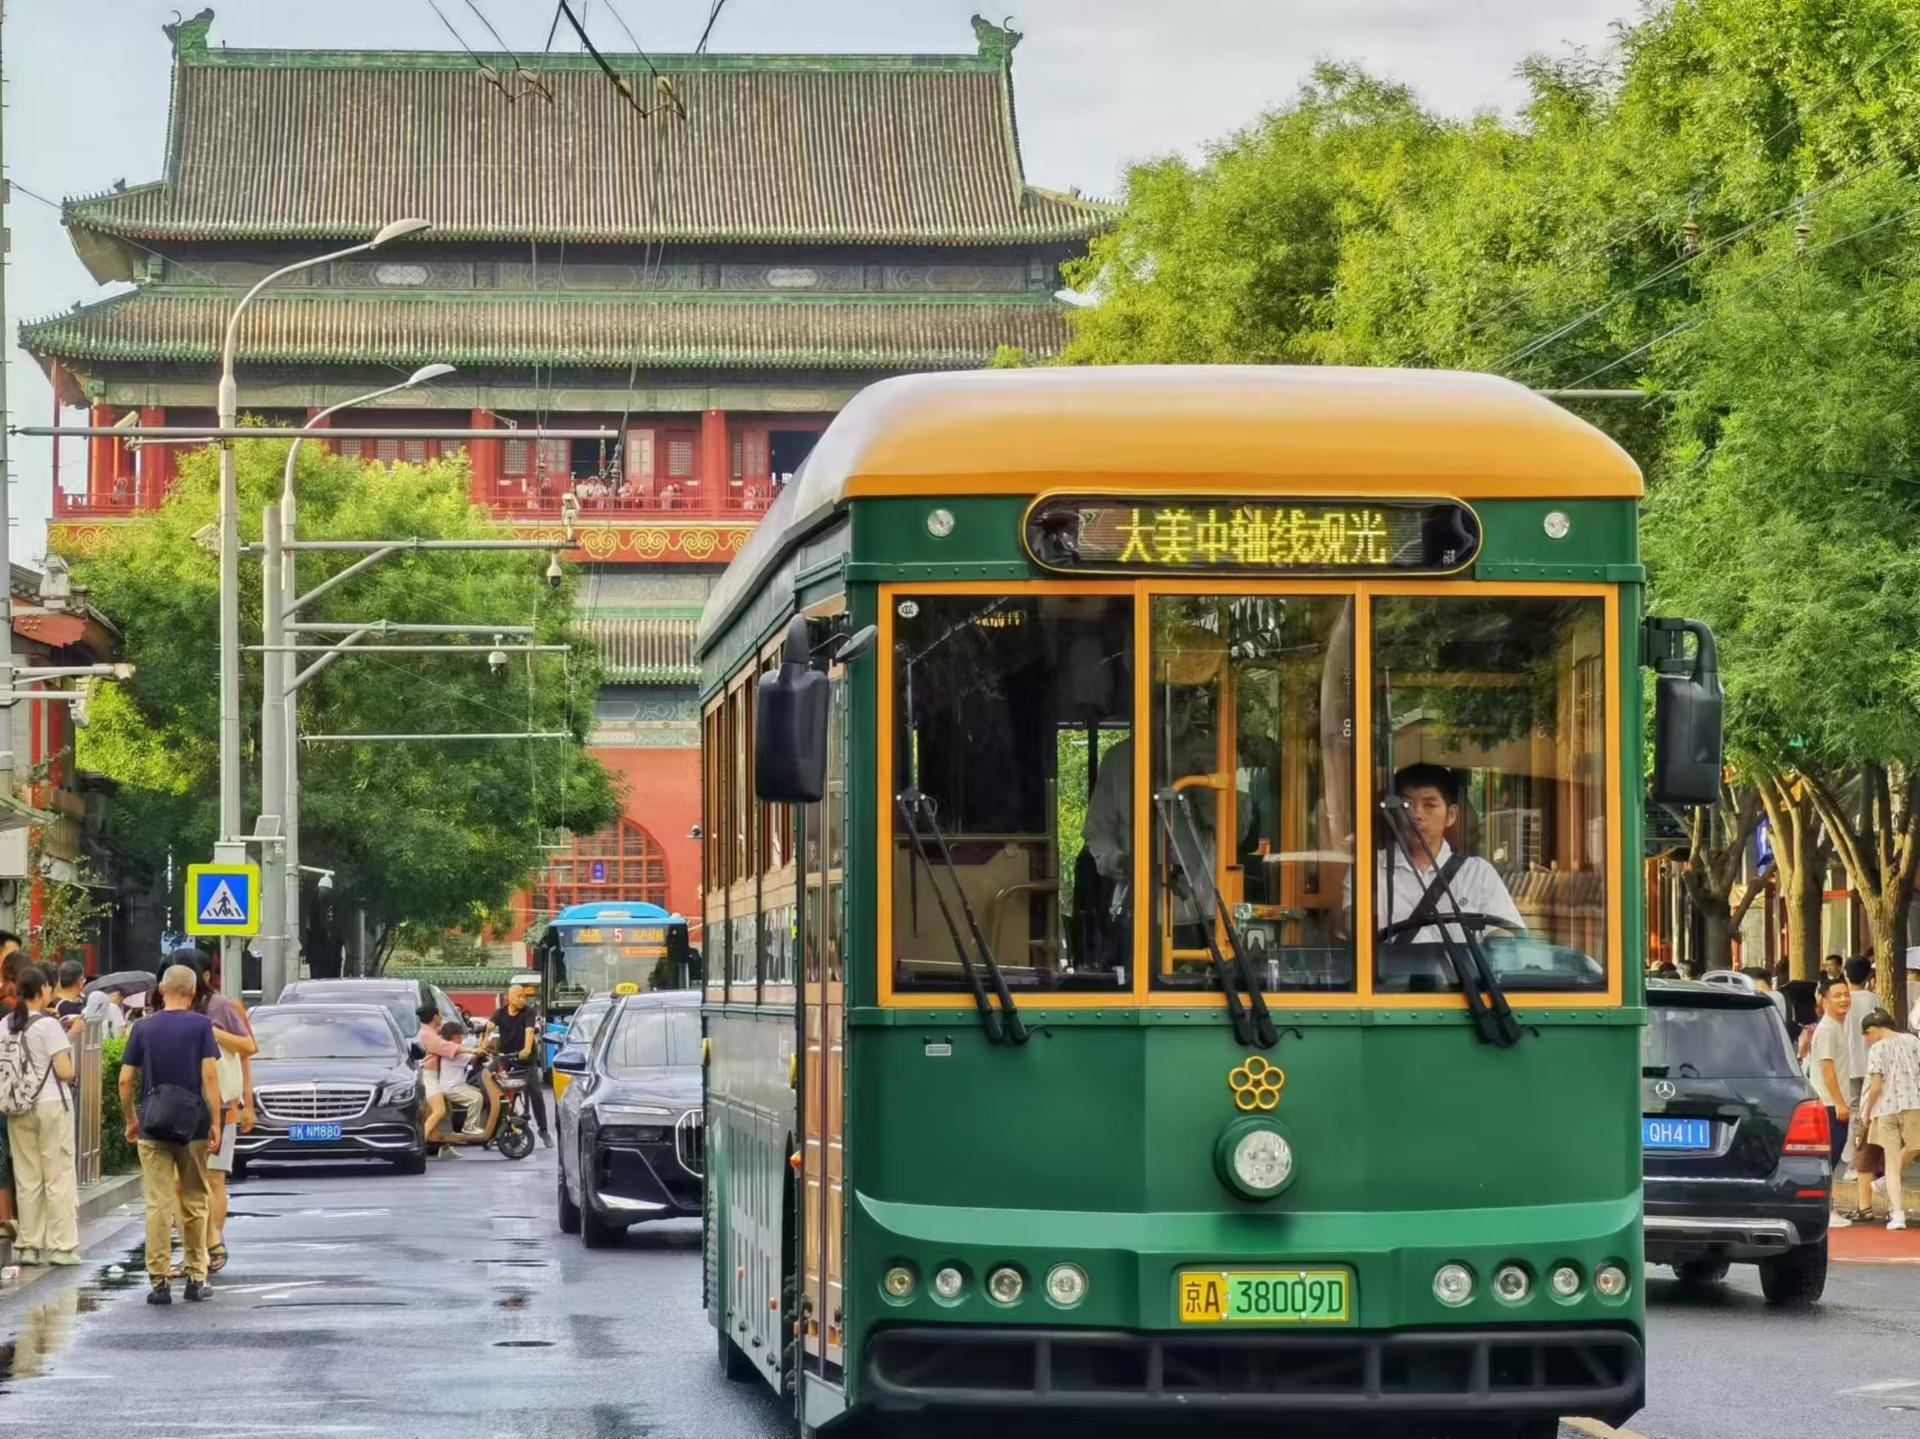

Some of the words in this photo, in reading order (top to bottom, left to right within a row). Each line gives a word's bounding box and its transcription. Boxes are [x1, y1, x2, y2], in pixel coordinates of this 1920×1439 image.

[1115, 508, 1387, 564] 大美中轴线观光
[613, 927, 624, 943] 5
[1185, 1280, 1220, 1314] 京A
[1236, 1280, 1343, 1314] 38009D
